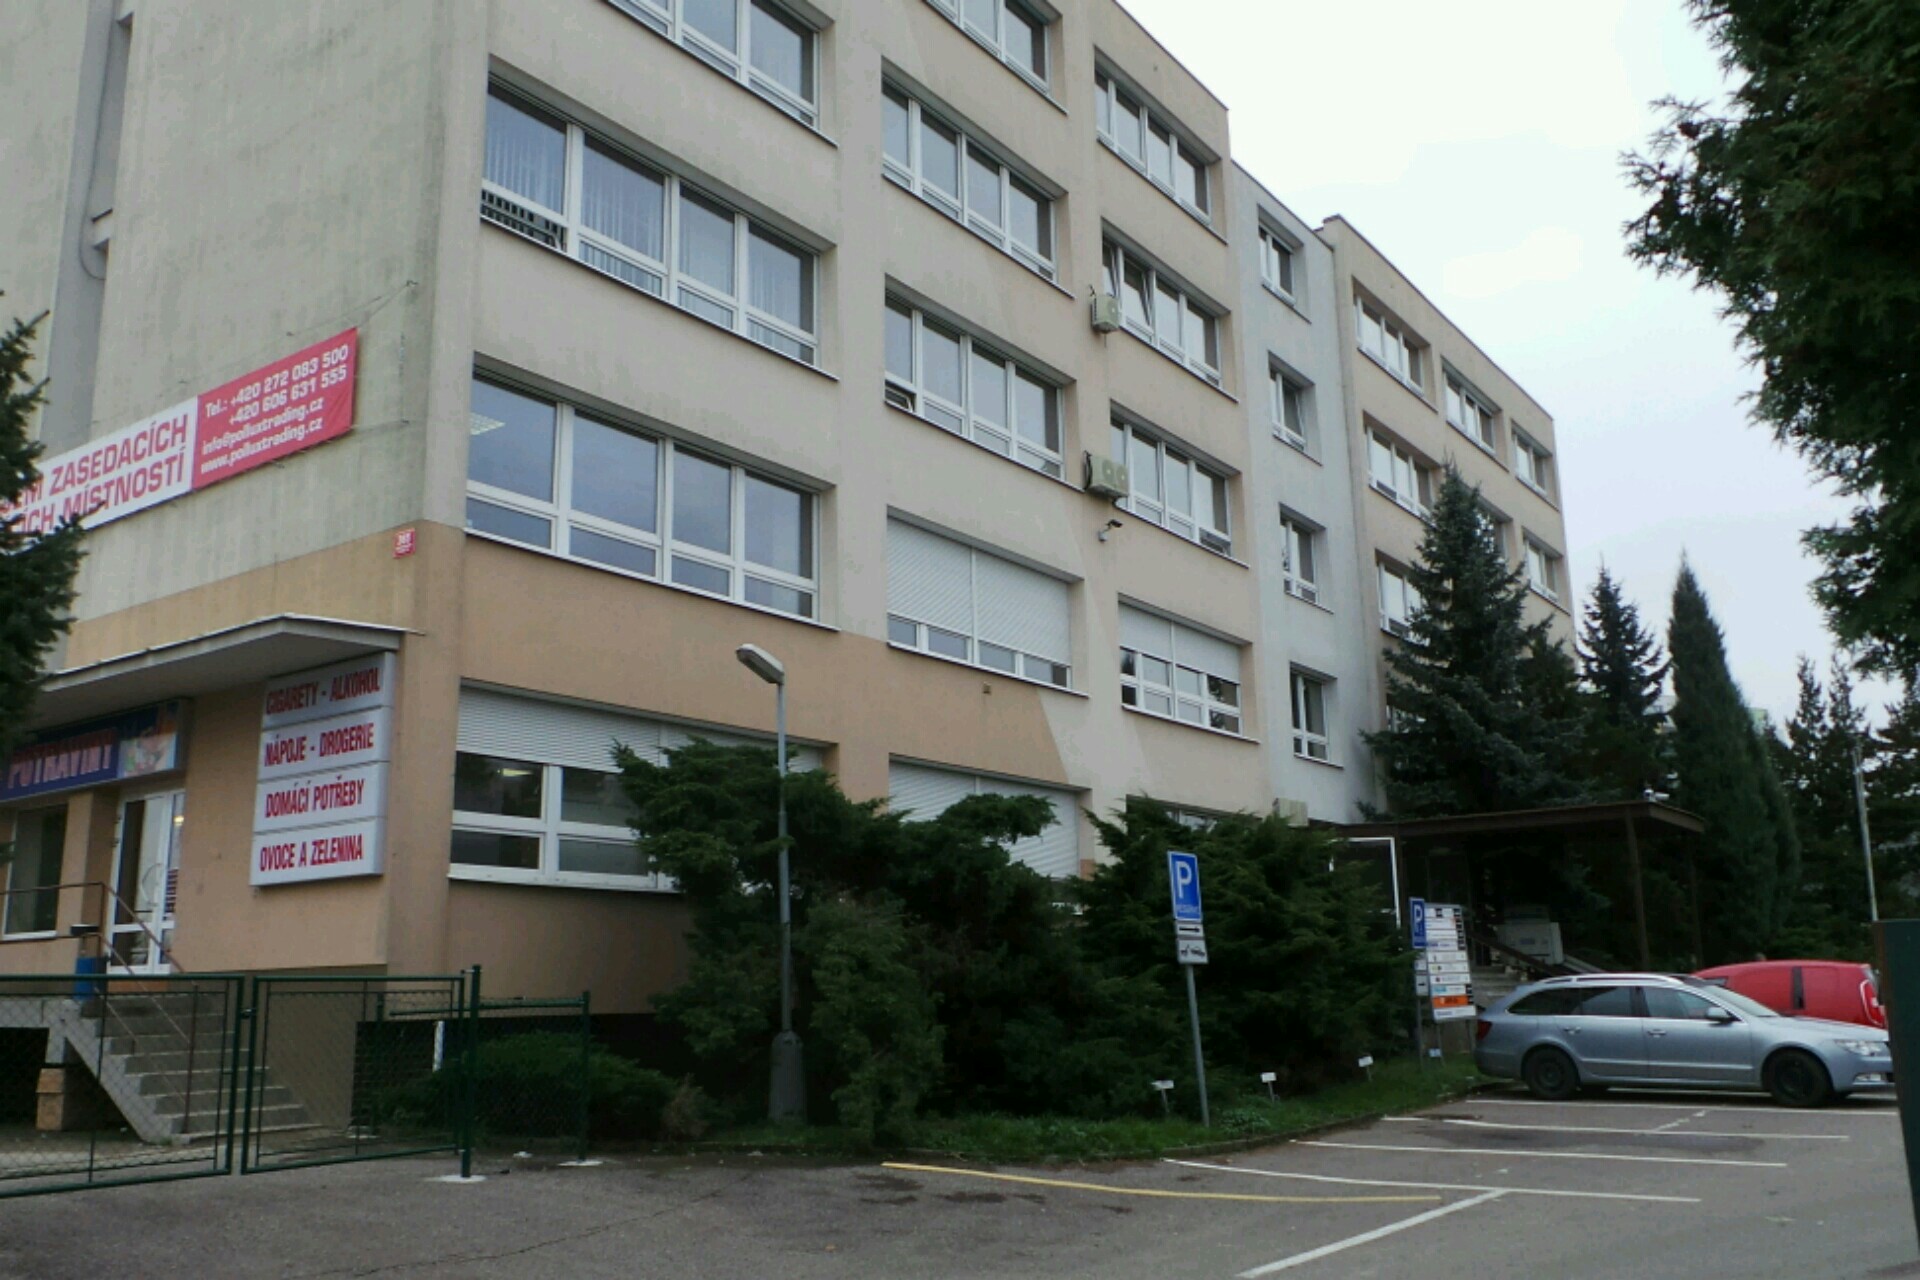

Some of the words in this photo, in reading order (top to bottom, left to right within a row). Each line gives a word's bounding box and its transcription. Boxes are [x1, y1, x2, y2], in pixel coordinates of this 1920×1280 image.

[229, 401, 259, 425] +420
[290, 378, 317, 401] 631
[321, 365, 347, 389] 555
[230, 382, 261, 407] +420
[263, 370, 289, 394] 272
[292, 357, 319, 381] 083
[322, 343, 349, 368] 500
[49, 414, 188, 496] ZASEDACÍCH
[62, 446, 187, 520] MÍSTNOSTÍ
[265, 681, 319, 715] CIGARETY
[329, 667, 381, 702] ALKOHOL
[264, 734, 307, 767] NÁPOJE
[319, 722, 375, 757] DROGERIE
[264, 780, 311, 818] DOMÁCÍ
[311, 775, 365, 811] POTŘEBY
[259, 843, 295, 872] OVOCE
[298, 841, 307, 867] A
[311, 834, 364, 866] ZELENINA
[1175, 860, 1192, 899] P
